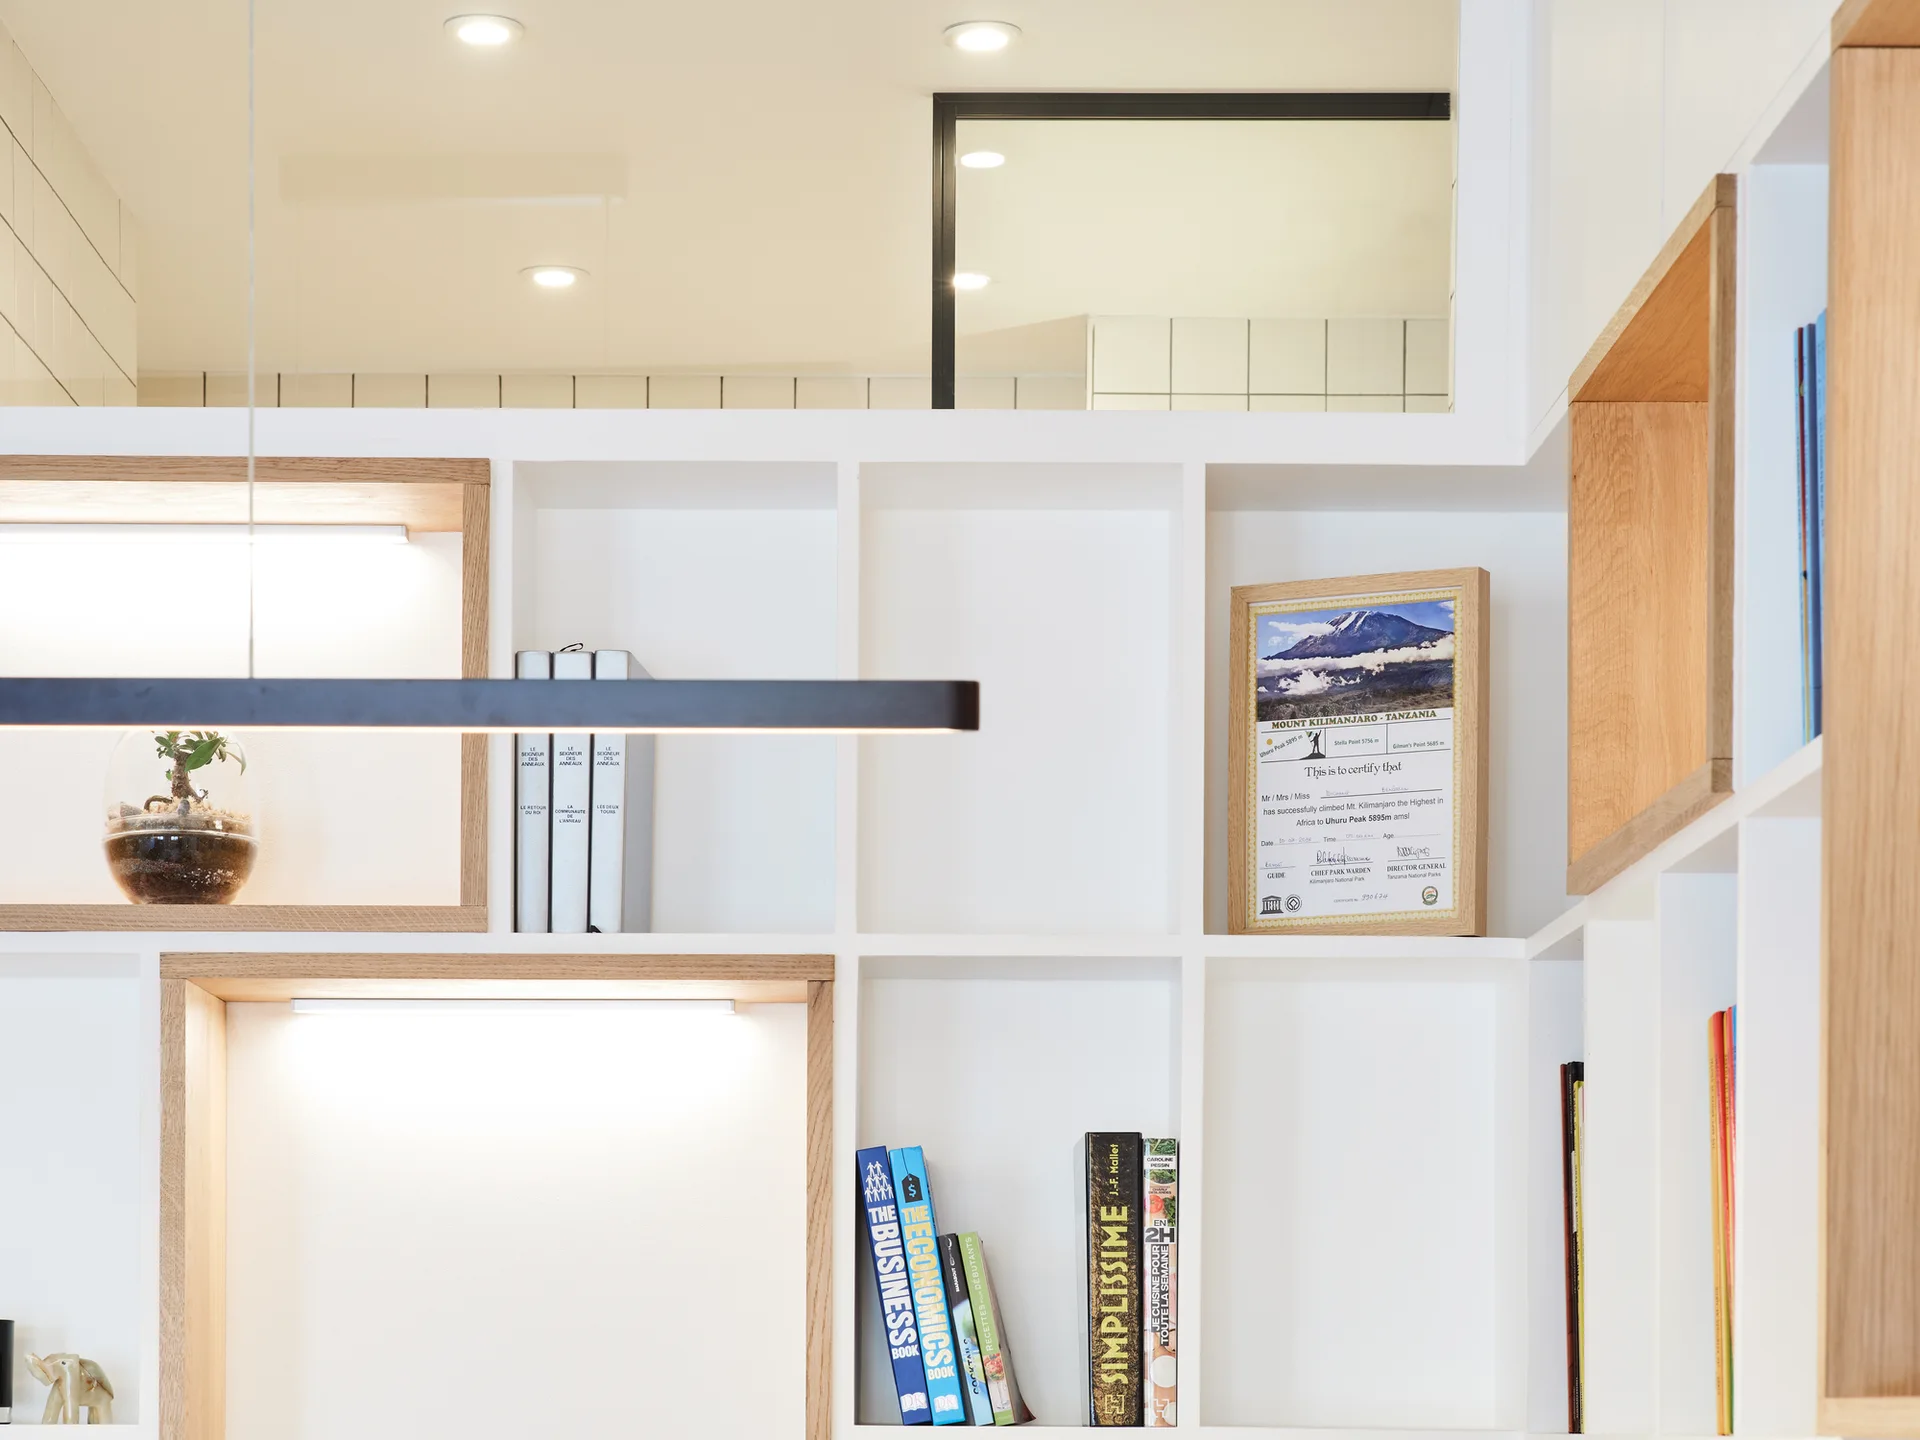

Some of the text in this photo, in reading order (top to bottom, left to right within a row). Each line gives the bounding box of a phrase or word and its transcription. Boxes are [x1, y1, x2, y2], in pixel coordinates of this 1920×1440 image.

[1271, 719, 1307, 730] MOUNT
[1309, 714, 1378, 727] KILIMANJARO
[1385, 710, 1437, 721] TANZANIA
[1260, 748, 1275, 758] Uhuru
[1274, 743, 1286, 752] Peak
[1286, 736, 1298, 746] 5895
[1304, 761, 1402, 779] This is to certify that
[1277, 806, 1317, 815] successfully
[1319, 803, 1345, 812] climbed
[1358, 800, 1396, 810] Kilimanjaro
[1397, 799, 1409, 807] the
[1410, 797, 1436, 807] Highest
[1437, 796, 1444, 804] in
[1296, 819, 1316, 827] Africa
[1325, 816, 1348, 825] Uhuru
[1349, 815, 1367, 823] Peak
[1368, 813, 1392, 822] 5895m
[1393, 812, 1410, 821] amsl
[1383, 832, 1395, 840] Age
[1310, 867, 1371, 877] CHIEF PARK WARDEN
[1387, 862, 1447, 872] DIRECTOR GENERAL
[1408, 871, 1427, 879] National
[1109, 1143, 1119, 1174] Mallet
[868, 1204, 898, 1224] THE
[901, 1205, 930, 1224] THE
[1153, 1219, 1167, 1227] EN
[1144, 1227, 1175, 1243] 2H
[965, 1236, 982, 1291] DÉBUTANTS
[871, 1221, 918, 1347] BUSINESS
[1151, 1245, 1160, 1331] JE CUISINE POUR
[904, 1221, 953, 1367] ECONOMICS
[1100, 1206, 1129, 1385] SIMPLISSIME
[1161, 1245, 1169, 1345] TOUTE LA SEMAINE
[978, 1304, 994, 1352] RECETTES
[891, 1344, 920, 1360] BOOK
[927, 1365, 956, 1381] BOOK
[902, 1393, 927, 1412] DK
[935, 1395, 958, 1412] DK
